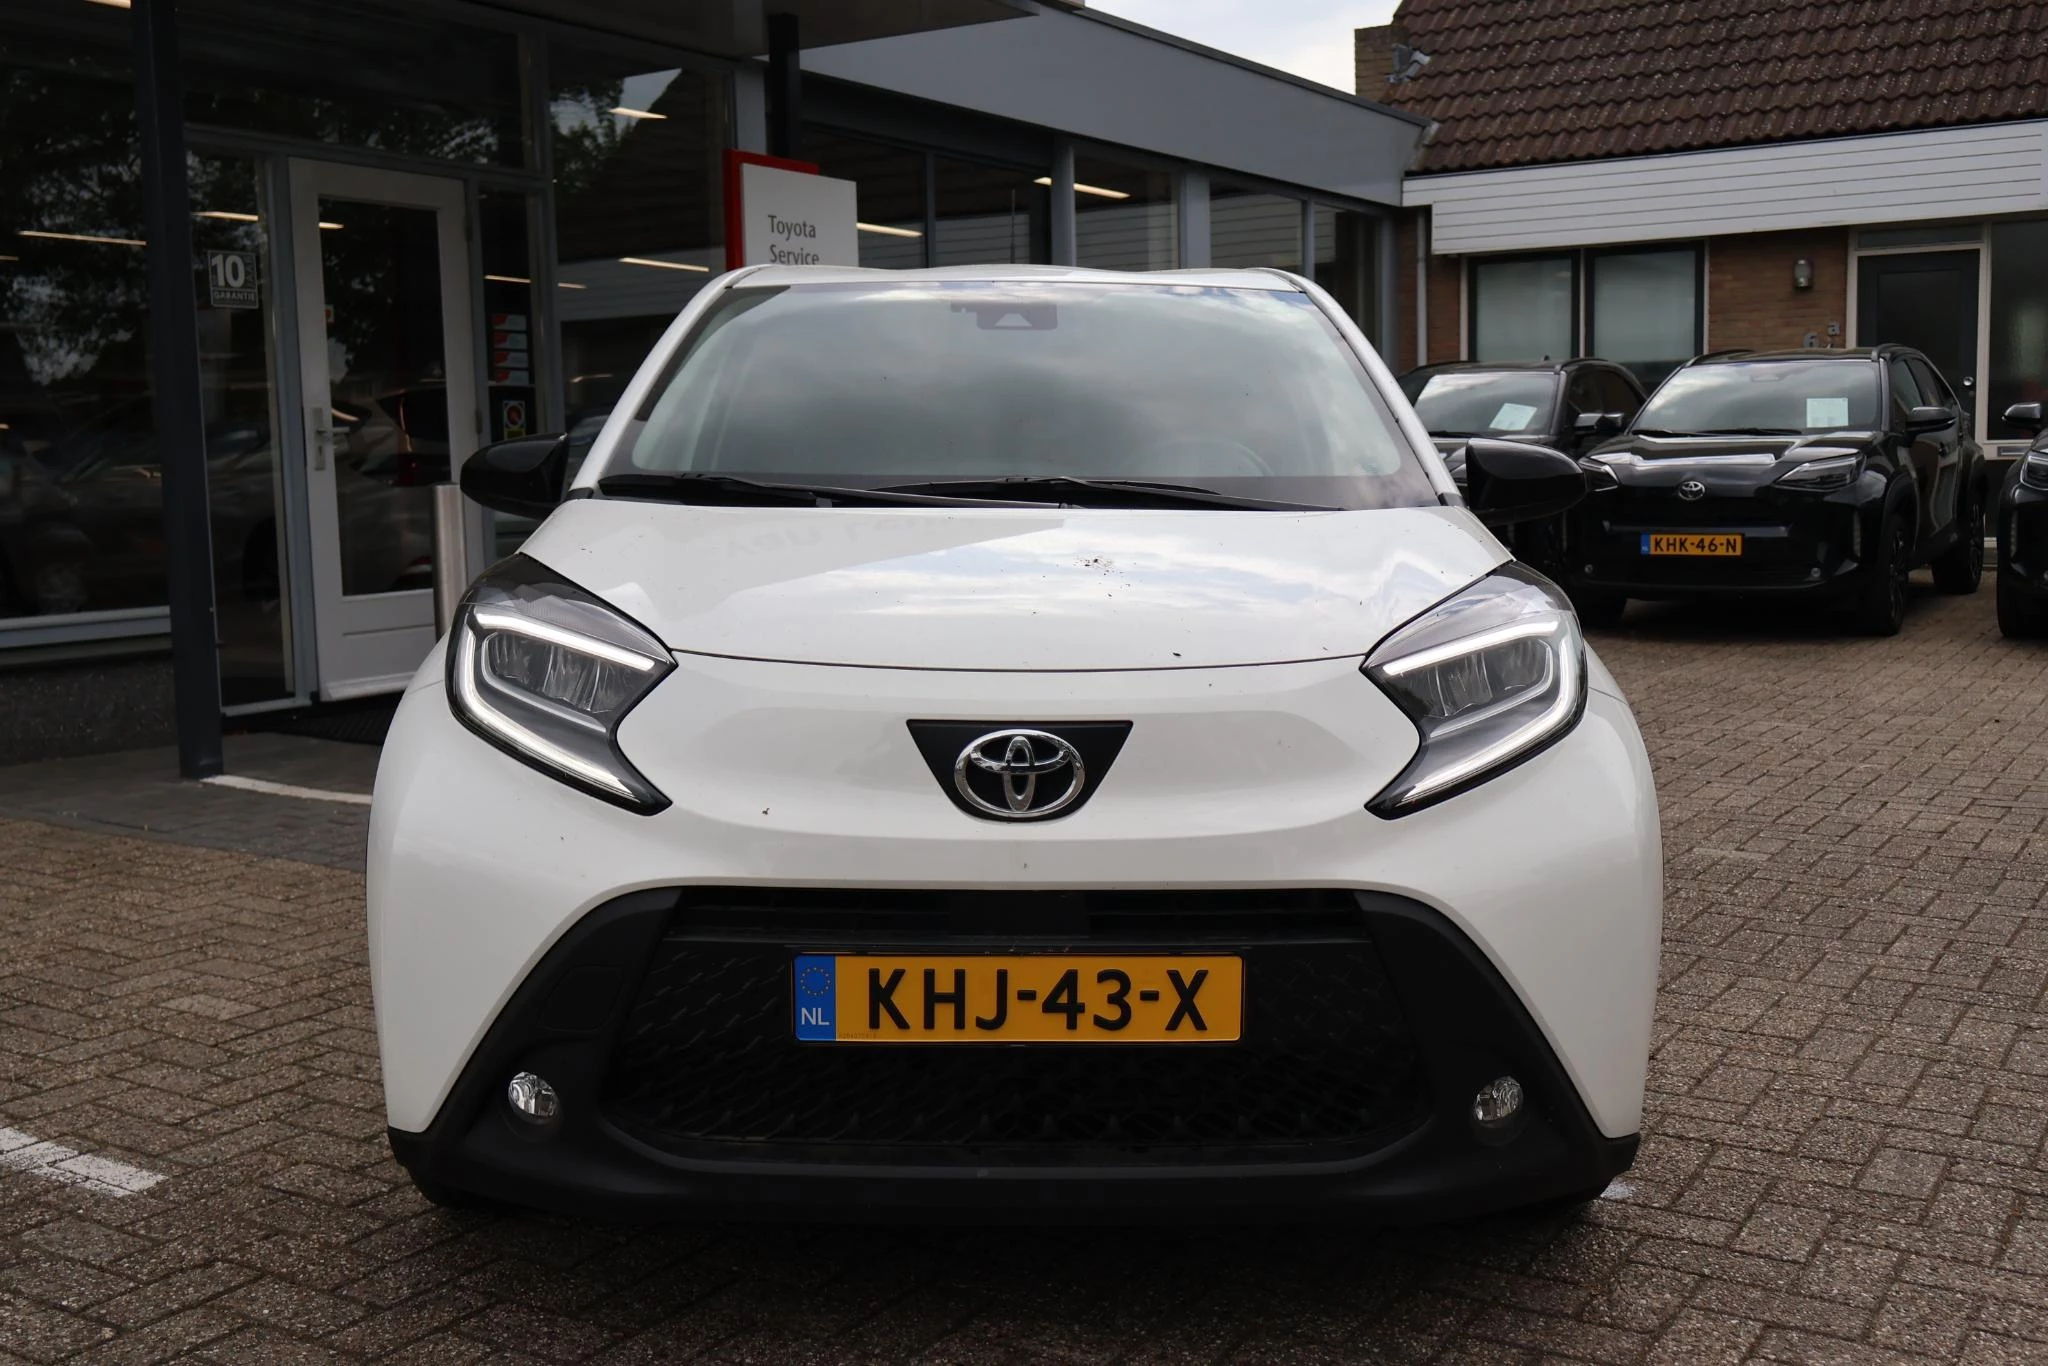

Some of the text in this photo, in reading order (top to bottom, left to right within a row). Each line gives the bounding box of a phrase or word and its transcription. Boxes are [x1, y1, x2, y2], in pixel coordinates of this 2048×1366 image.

[768, 214, 817, 241] Toyota
[769, 244, 820, 266] Service
[211, 254, 245, 288] 10
[1654, 537, 1737, 553] KHK-46-N
[867, 967, 1209, 1031] KHJ-43-X
[801, 1007, 830, 1026] NL
